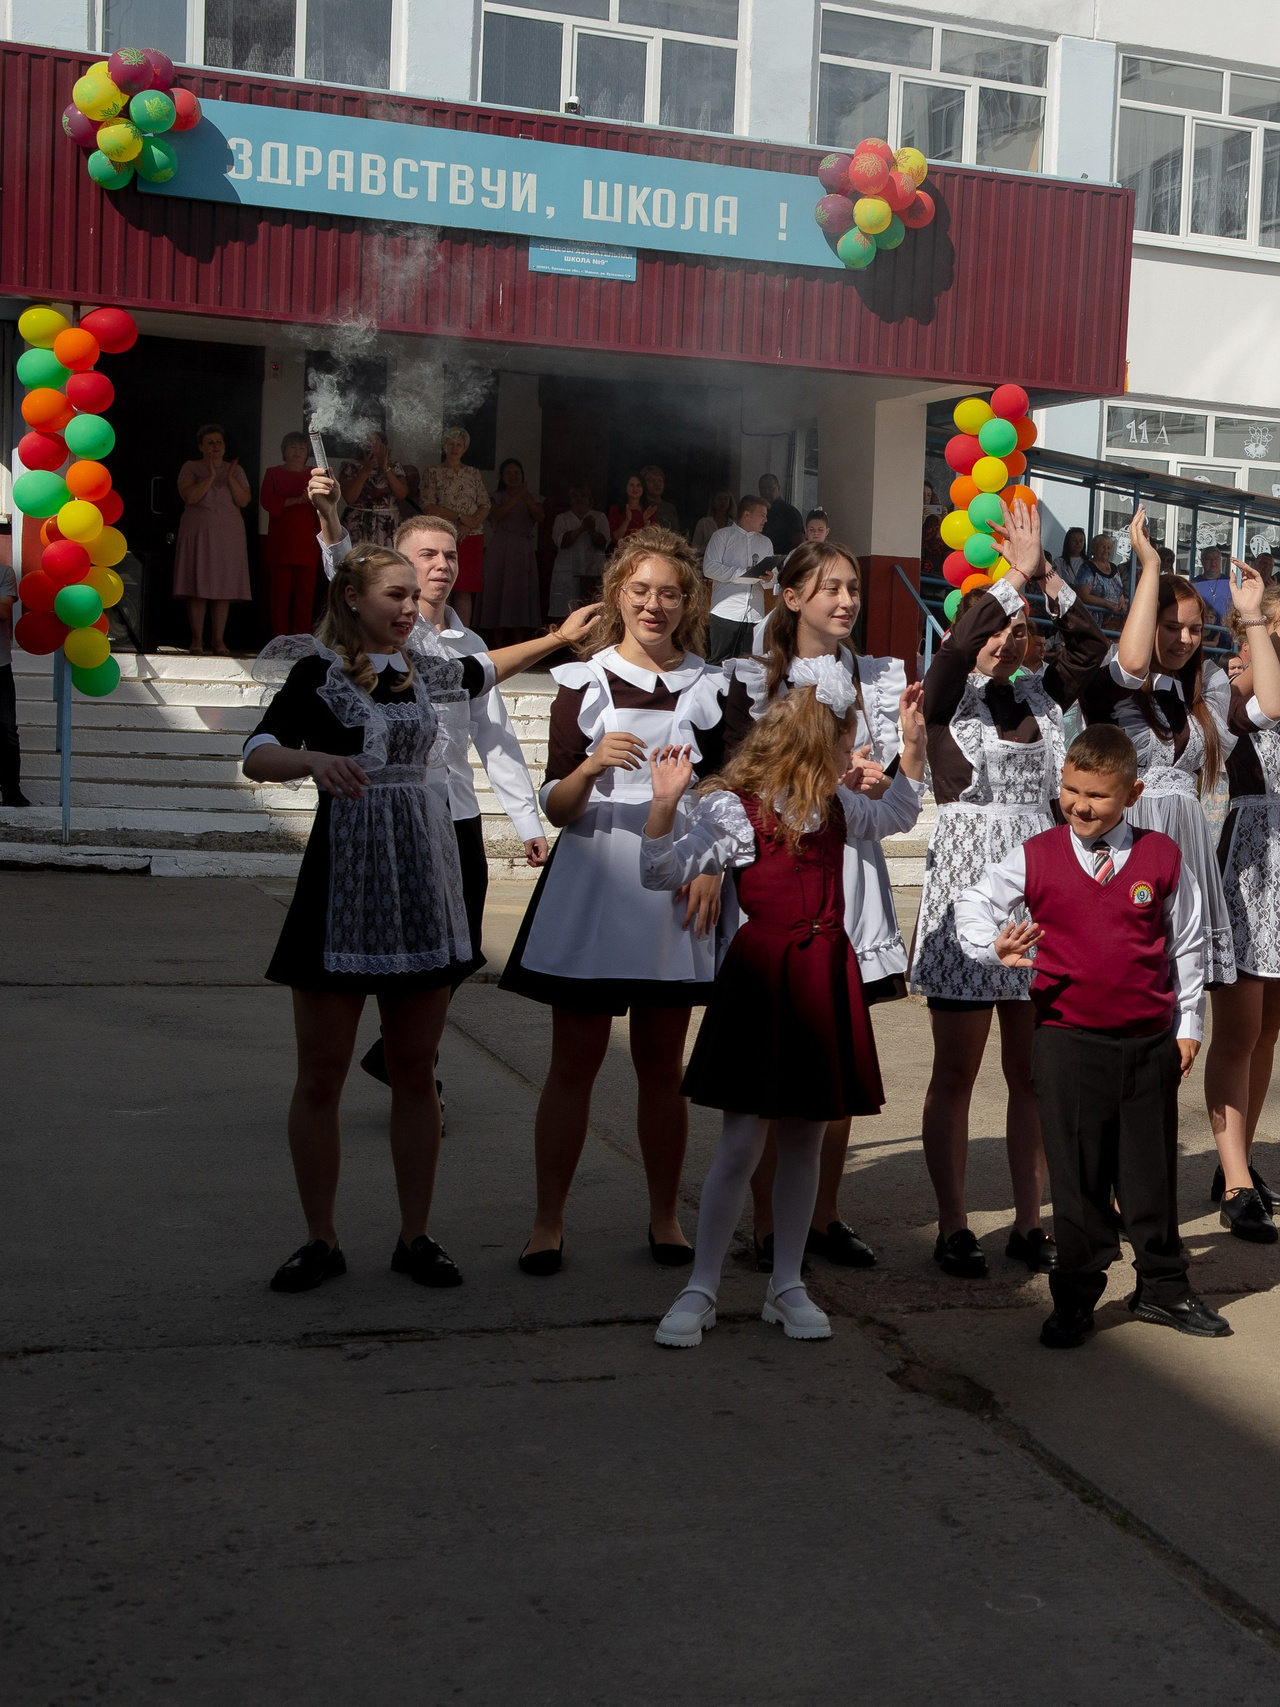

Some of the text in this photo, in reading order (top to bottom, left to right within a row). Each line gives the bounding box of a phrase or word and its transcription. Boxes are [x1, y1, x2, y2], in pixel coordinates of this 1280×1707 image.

[226, 137, 555, 219] ЗДРАВСТВУЙ,
[583, 180, 738, 235] ШКОЛА
[540, 244, 633, 260] ОБЩЕОБРАЗОВАТЕЛЬНАЯ
[564, 255, 591, 264] ШКОЛА
[1125, 419, 1149, 444] 11
